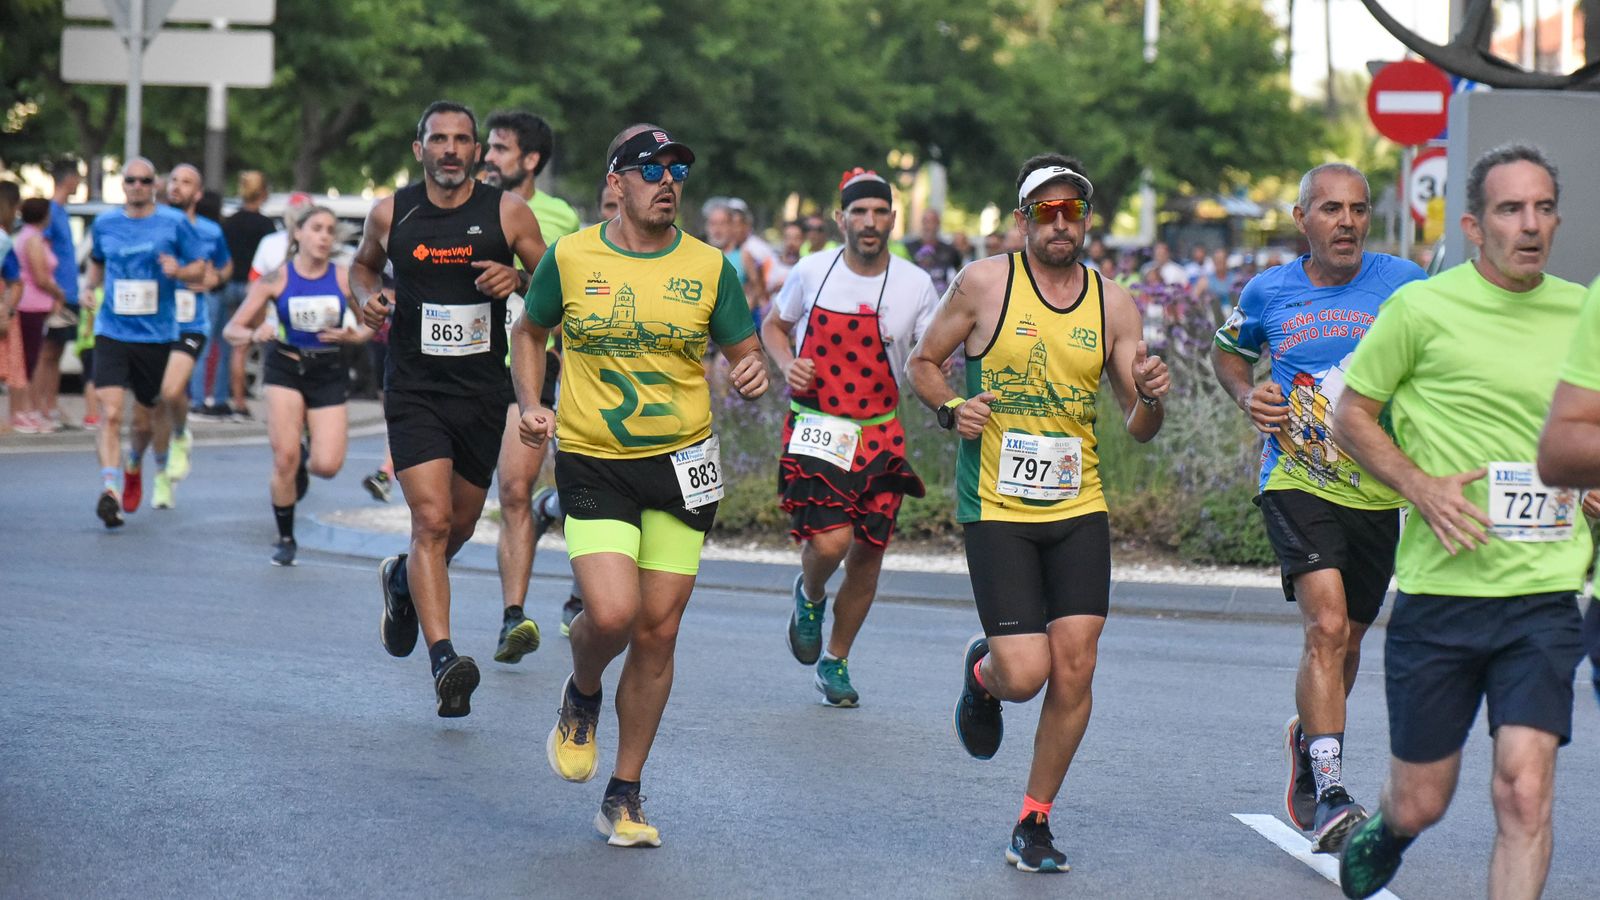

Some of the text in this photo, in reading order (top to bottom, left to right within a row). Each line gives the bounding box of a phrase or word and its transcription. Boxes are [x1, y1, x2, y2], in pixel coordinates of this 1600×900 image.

[431, 323, 464, 342] 863
[1281, 312, 1315, 335] PEÑA
[1278, 327, 1319, 354] SIENTO
[1322, 325, 1348, 337] LAS
[801, 427, 832, 447] 839
[1006, 438, 1022, 449] XXI
[676, 451, 690, 463] XXI
[688, 461, 718, 489] 883
[1012, 456, 1052, 482] 797
[1504, 492, 1548, 519] 727
